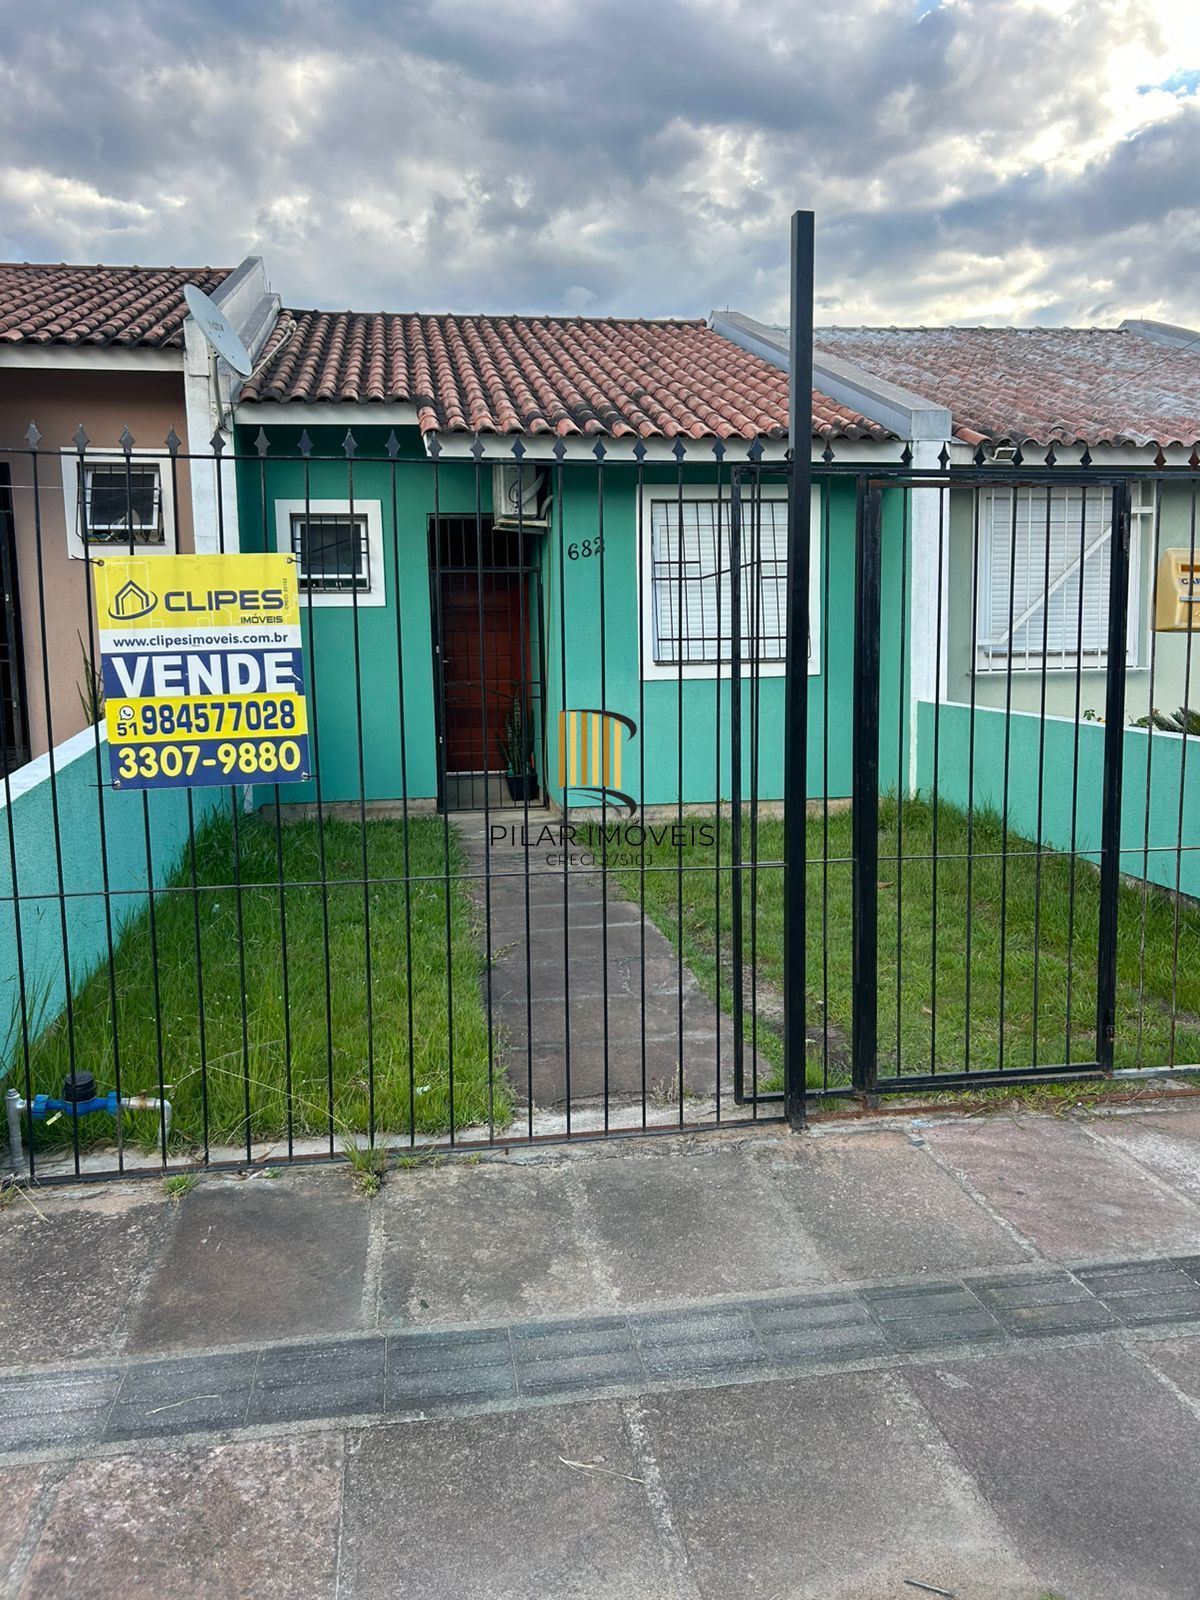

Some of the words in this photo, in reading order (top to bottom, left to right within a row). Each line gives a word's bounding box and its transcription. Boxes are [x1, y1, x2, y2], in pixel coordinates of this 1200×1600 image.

[568, 536, 605, 560] 682
[164, 589, 284, 612] CLIPES
[240, 613, 284, 624] IMÓVEIS
[113, 632, 288, 648] www.clipesimoveis.com.br
[111, 652, 295, 698] VENDE
[117, 722, 138, 736] 51
[141, 699, 295, 735] 984577028
[118, 740, 301, 779] 3307-9880
